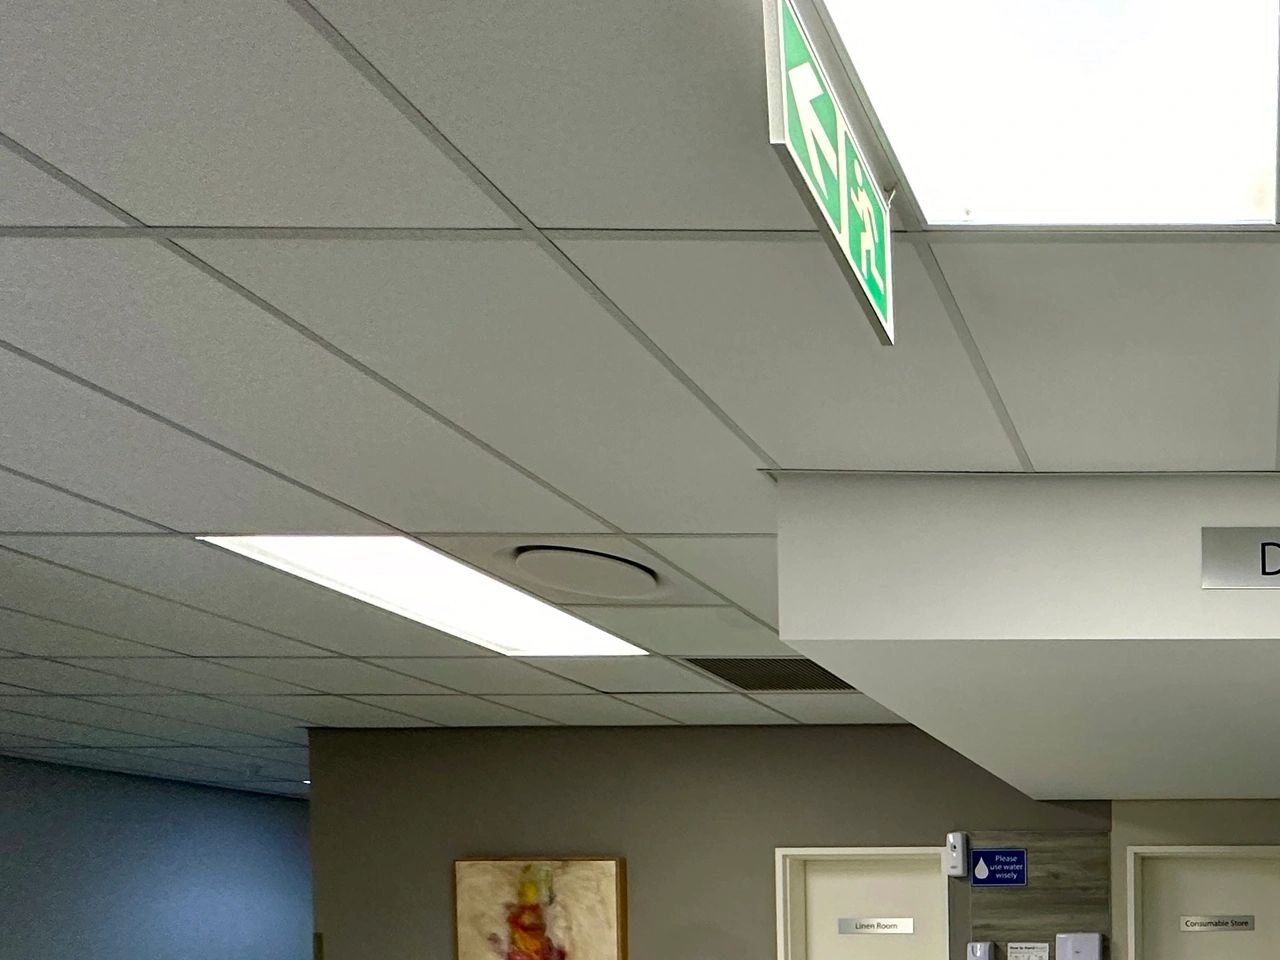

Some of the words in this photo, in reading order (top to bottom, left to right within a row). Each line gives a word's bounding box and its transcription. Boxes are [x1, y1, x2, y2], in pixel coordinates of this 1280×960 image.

[995, 872, 1018, 880] wisely
[855, 922, 875, 930] Linen
[876, 922, 898, 930] Room
[1184, 919, 1230, 928] Consumable
[1230, 919, 1249, 928] Store
